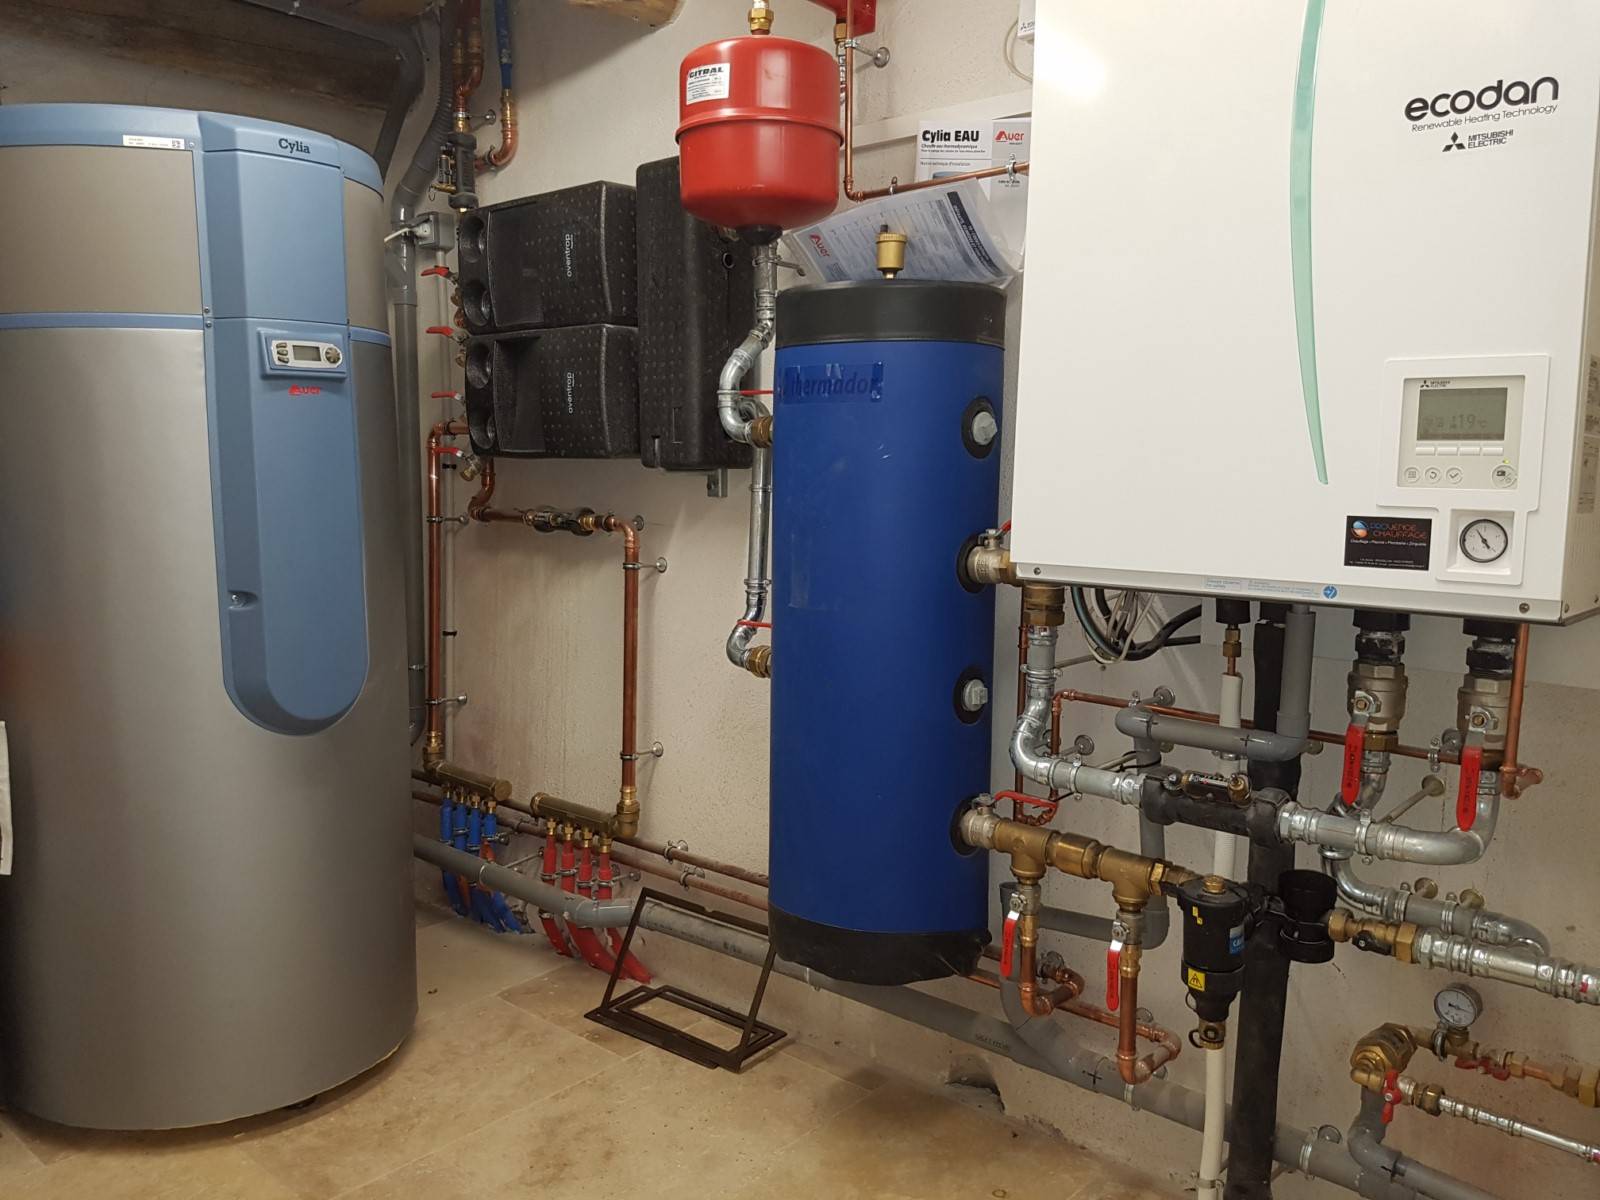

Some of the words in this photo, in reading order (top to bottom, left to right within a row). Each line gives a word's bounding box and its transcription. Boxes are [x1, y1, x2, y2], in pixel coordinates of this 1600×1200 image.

[1404, 76, 1559, 122] ecodan
[1412, 116, 1463, 132] Renewable
[1464, 111, 1501, 125] Heating
[1502, 103, 1558, 119] Technology
[922, 129, 951, 143] Cylia
[954, 130, 980, 142] EAU
[995, 130, 1025, 142] Auer
[1468, 129, 1514, 142] MITSUBISHI
[1468, 138, 1507, 149] ELECTRIC
[278, 138, 311, 154] Cylia
[809, 234, 830, 257] Auer
[565, 234, 573, 278] oventrop
[566, 372, 574, 414] oventrop
